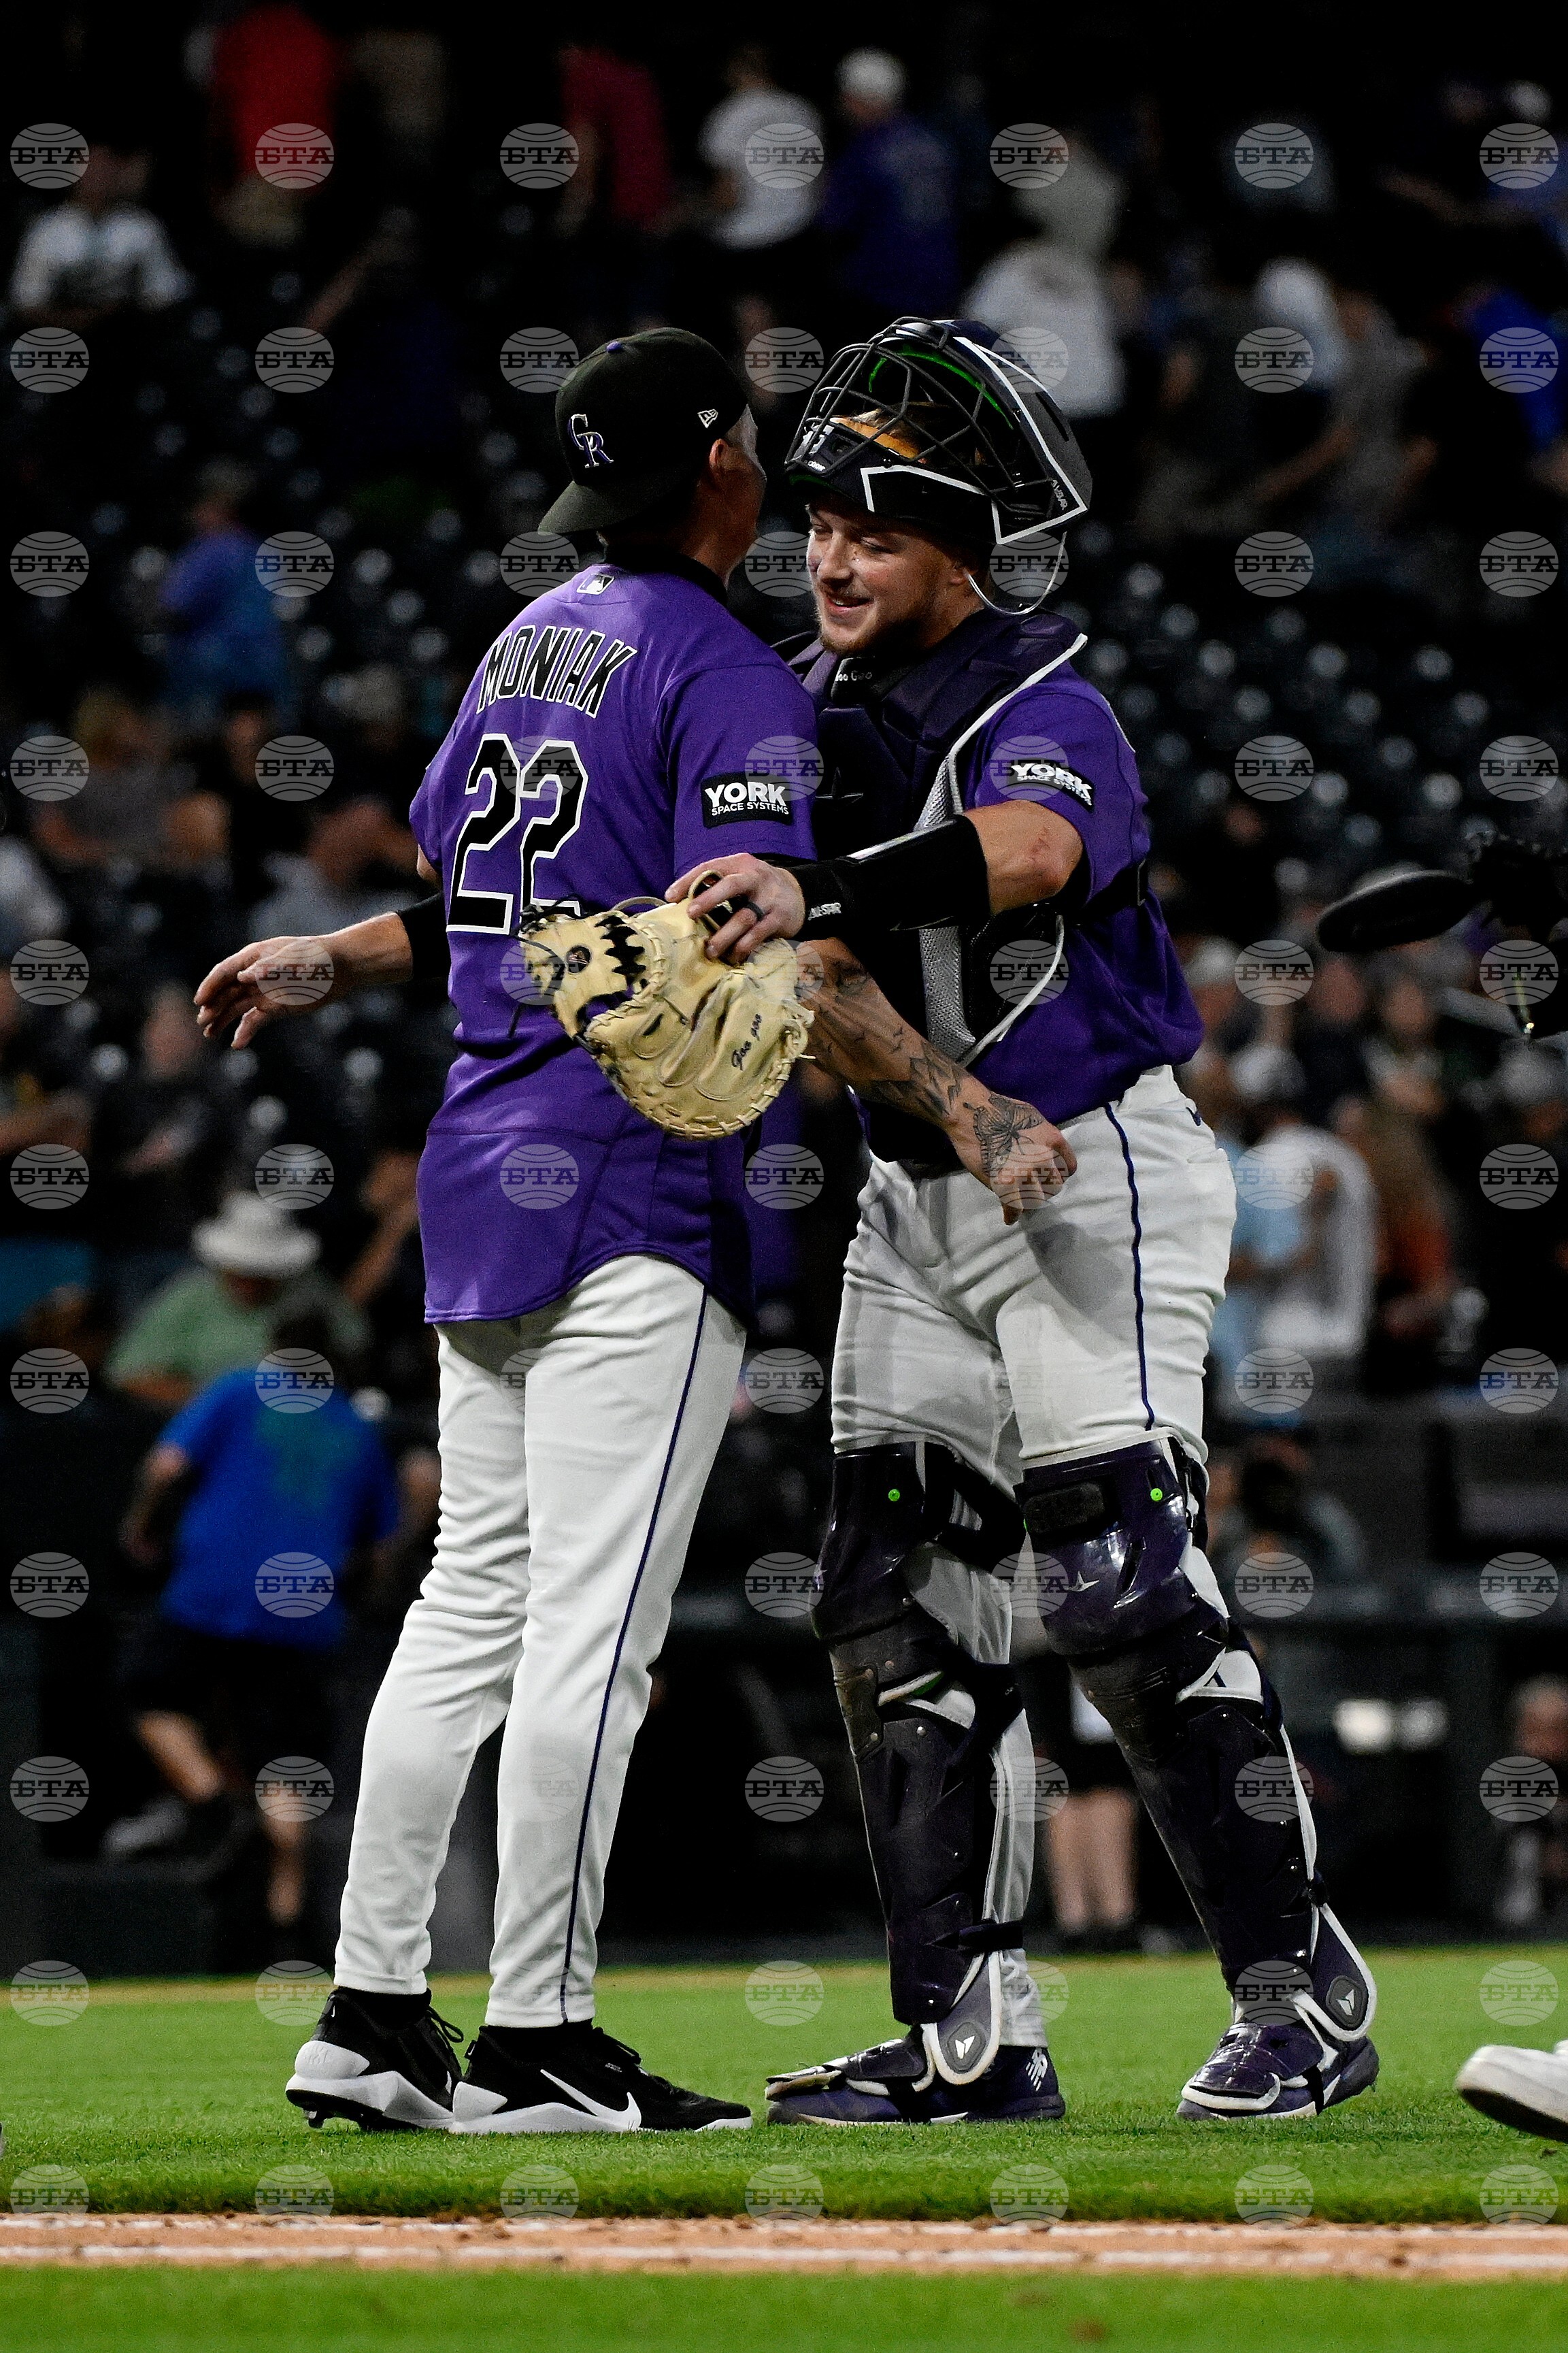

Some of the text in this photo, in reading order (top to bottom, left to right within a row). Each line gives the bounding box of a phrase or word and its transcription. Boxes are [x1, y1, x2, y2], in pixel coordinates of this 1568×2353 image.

[476, 625, 637, 719] MONIAK
[705, 781, 787, 808] YORK
[1011, 763, 1093, 800] YORK
[711, 802, 789, 816] SPACE SYSTEMS
[446, 733, 589, 936] 22
